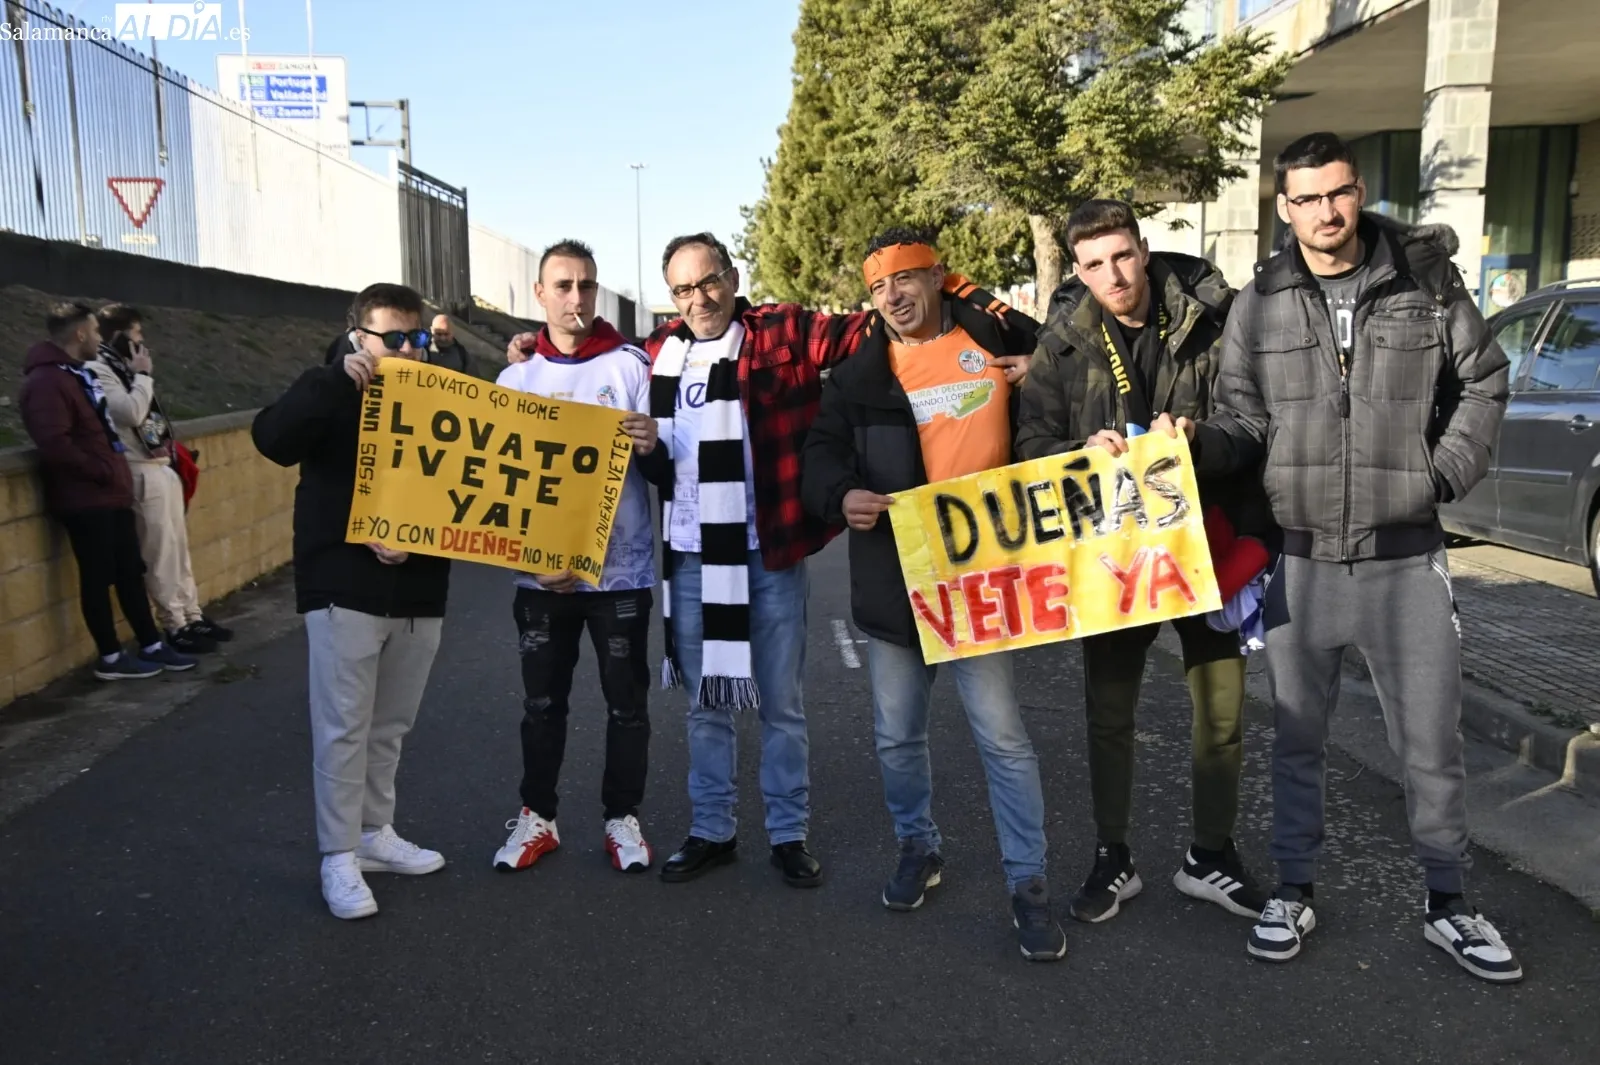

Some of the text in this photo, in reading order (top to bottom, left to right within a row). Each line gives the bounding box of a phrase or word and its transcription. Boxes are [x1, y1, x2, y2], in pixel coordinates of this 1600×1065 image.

[489, 390, 509, 409] GO
[517, 399, 560, 420] HOME
[946, 391, 976, 402] LÓPEZ
[390, 401, 599, 474] LOVATO
[447, 489, 531, 535] YA!
[934, 455, 1191, 564] DUEÑAS
[397, 523, 434, 546] CON
[440, 526, 522, 562] DUEÑAS
[522, 547, 542, 565] NO
[546, 552, 563, 570] ME
[567, 554, 602, 579] ABONO
[909, 545, 1198, 649] VETE YA
